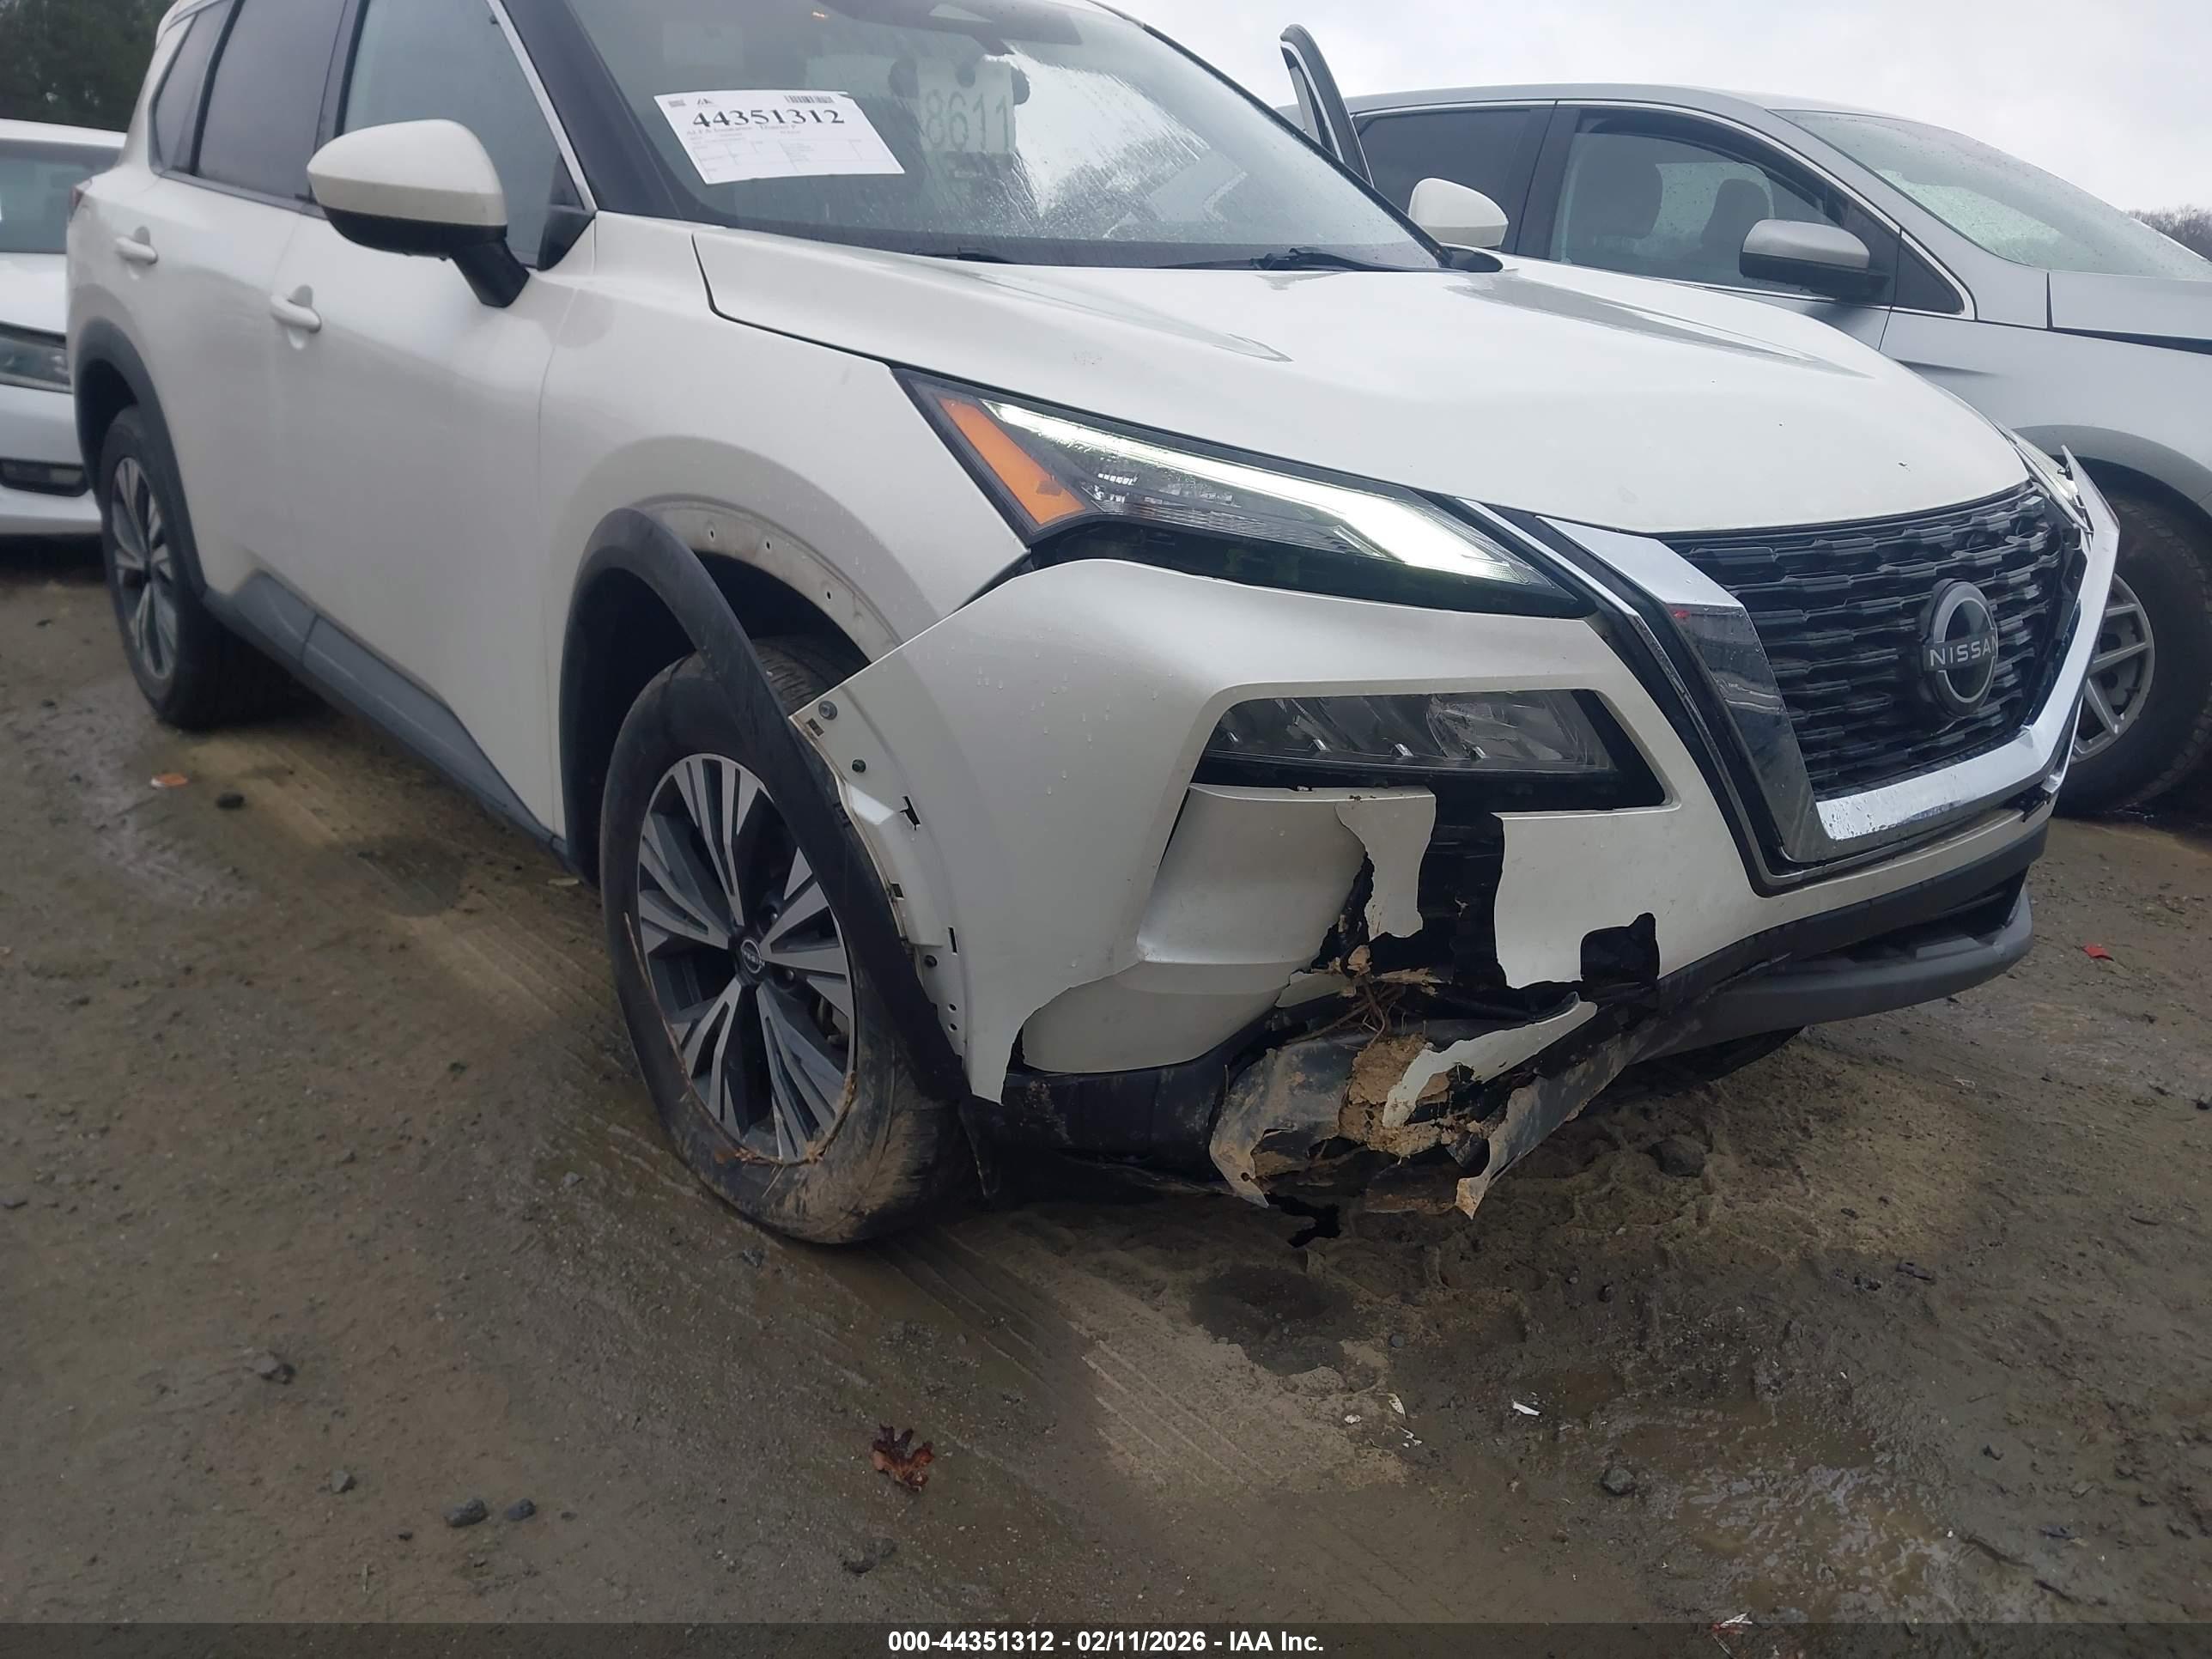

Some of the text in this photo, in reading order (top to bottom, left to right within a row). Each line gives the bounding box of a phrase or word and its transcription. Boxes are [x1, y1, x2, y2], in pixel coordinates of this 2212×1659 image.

[692, 109, 845, 128] 44351312
[925, 88, 1010, 152] 8611
[1929, 635, 1997, 666] NISSAN
